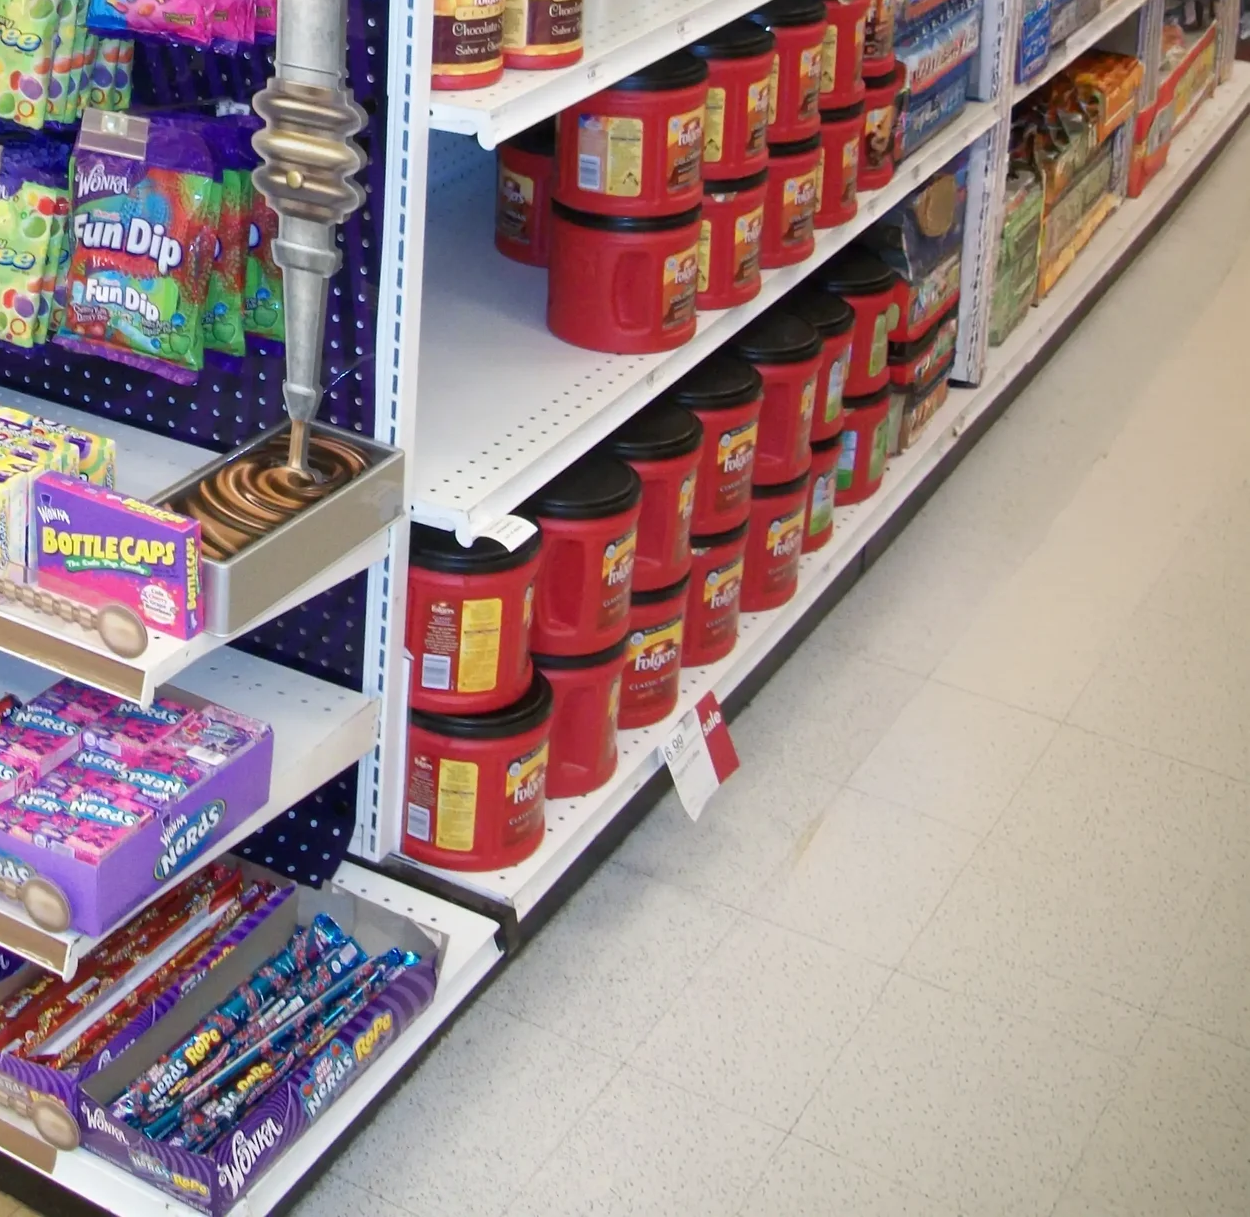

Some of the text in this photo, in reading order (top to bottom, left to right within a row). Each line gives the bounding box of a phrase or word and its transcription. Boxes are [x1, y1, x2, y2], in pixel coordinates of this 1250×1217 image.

[452, 21, 497, 37] Chocolate
[75, 164, 130, 198] WONKA
[42, 526, 176, 566] BOTTLE CAPS
[635, 649, 677, 672] Folgers
[702, 709, 721, 737] sale
[81, 1101, 129, 1146] WONKA
[219, 1116, 283, 1198] WONKA
